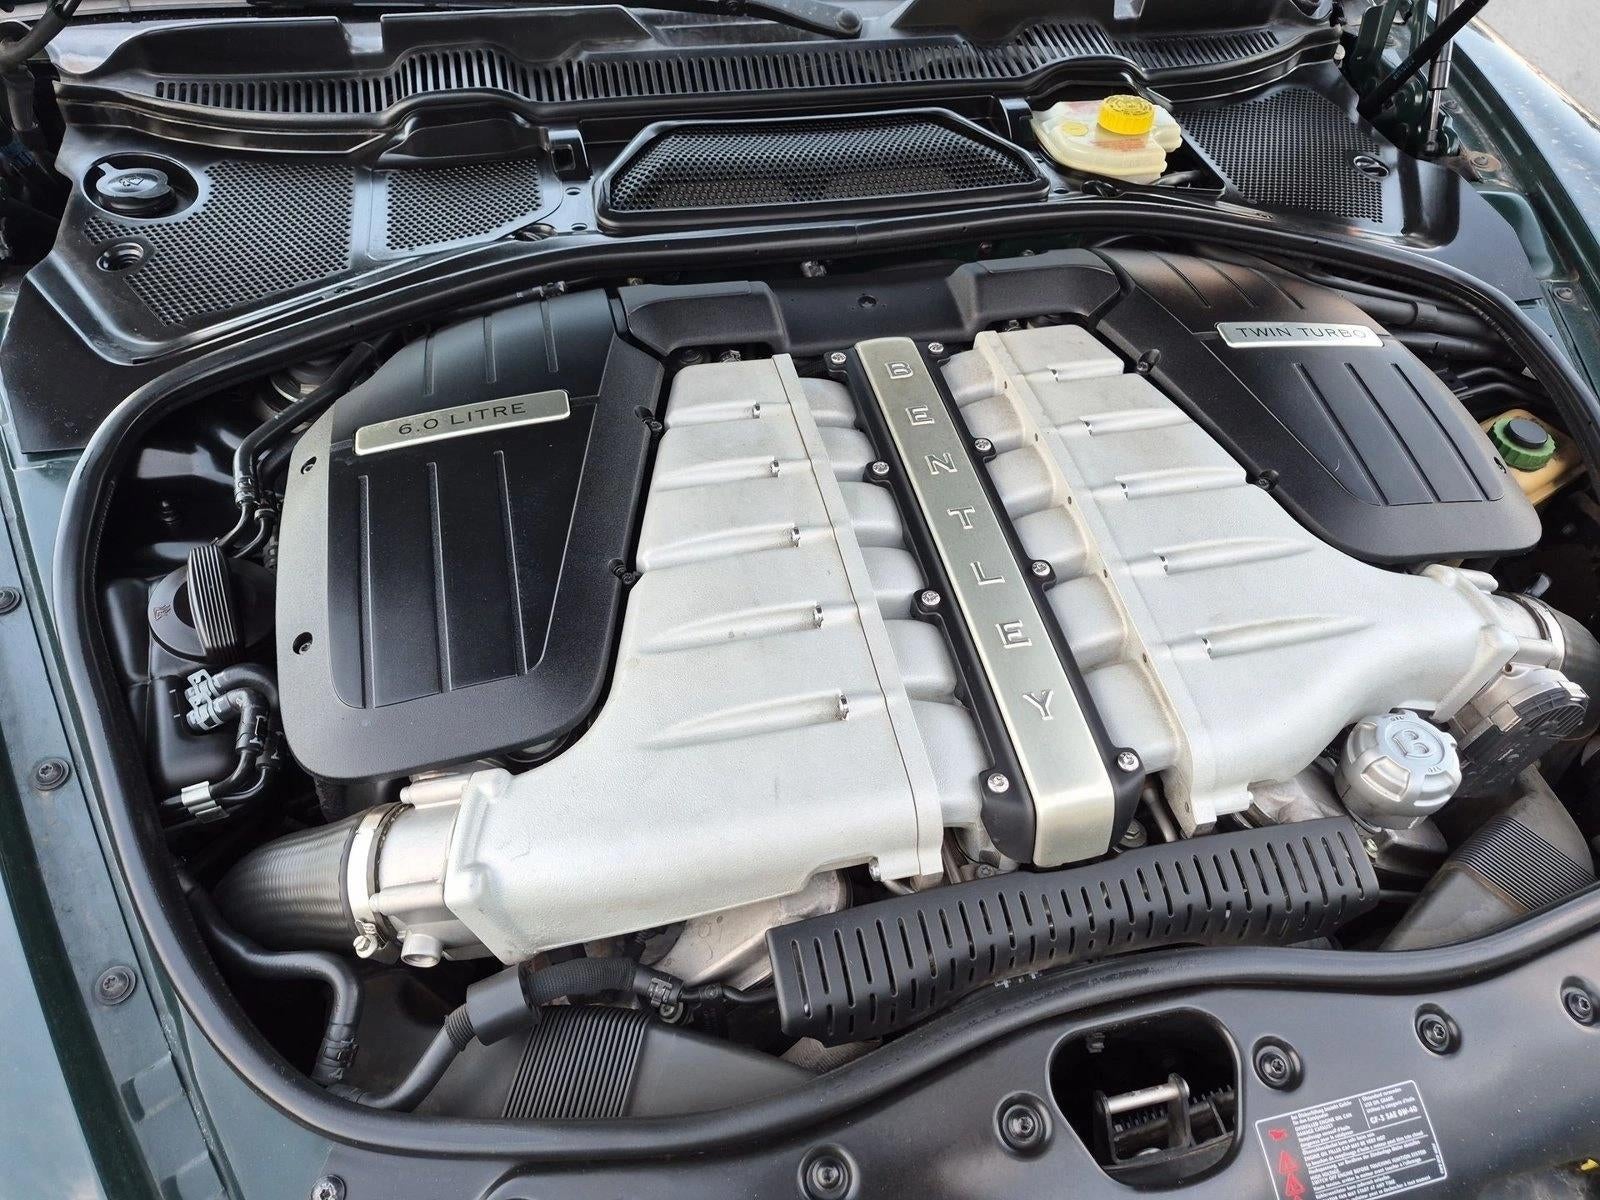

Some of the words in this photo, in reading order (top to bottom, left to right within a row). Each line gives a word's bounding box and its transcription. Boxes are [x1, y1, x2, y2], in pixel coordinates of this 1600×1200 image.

[1236, 327, 1292, 337] TWIN
[1297, 327, 1367, 338] TURBO
[399, 418, 439, 435] 6.0
[450, 402, 526, 425] LITRE
[884, 361, 1054, 721] BENTLEY
